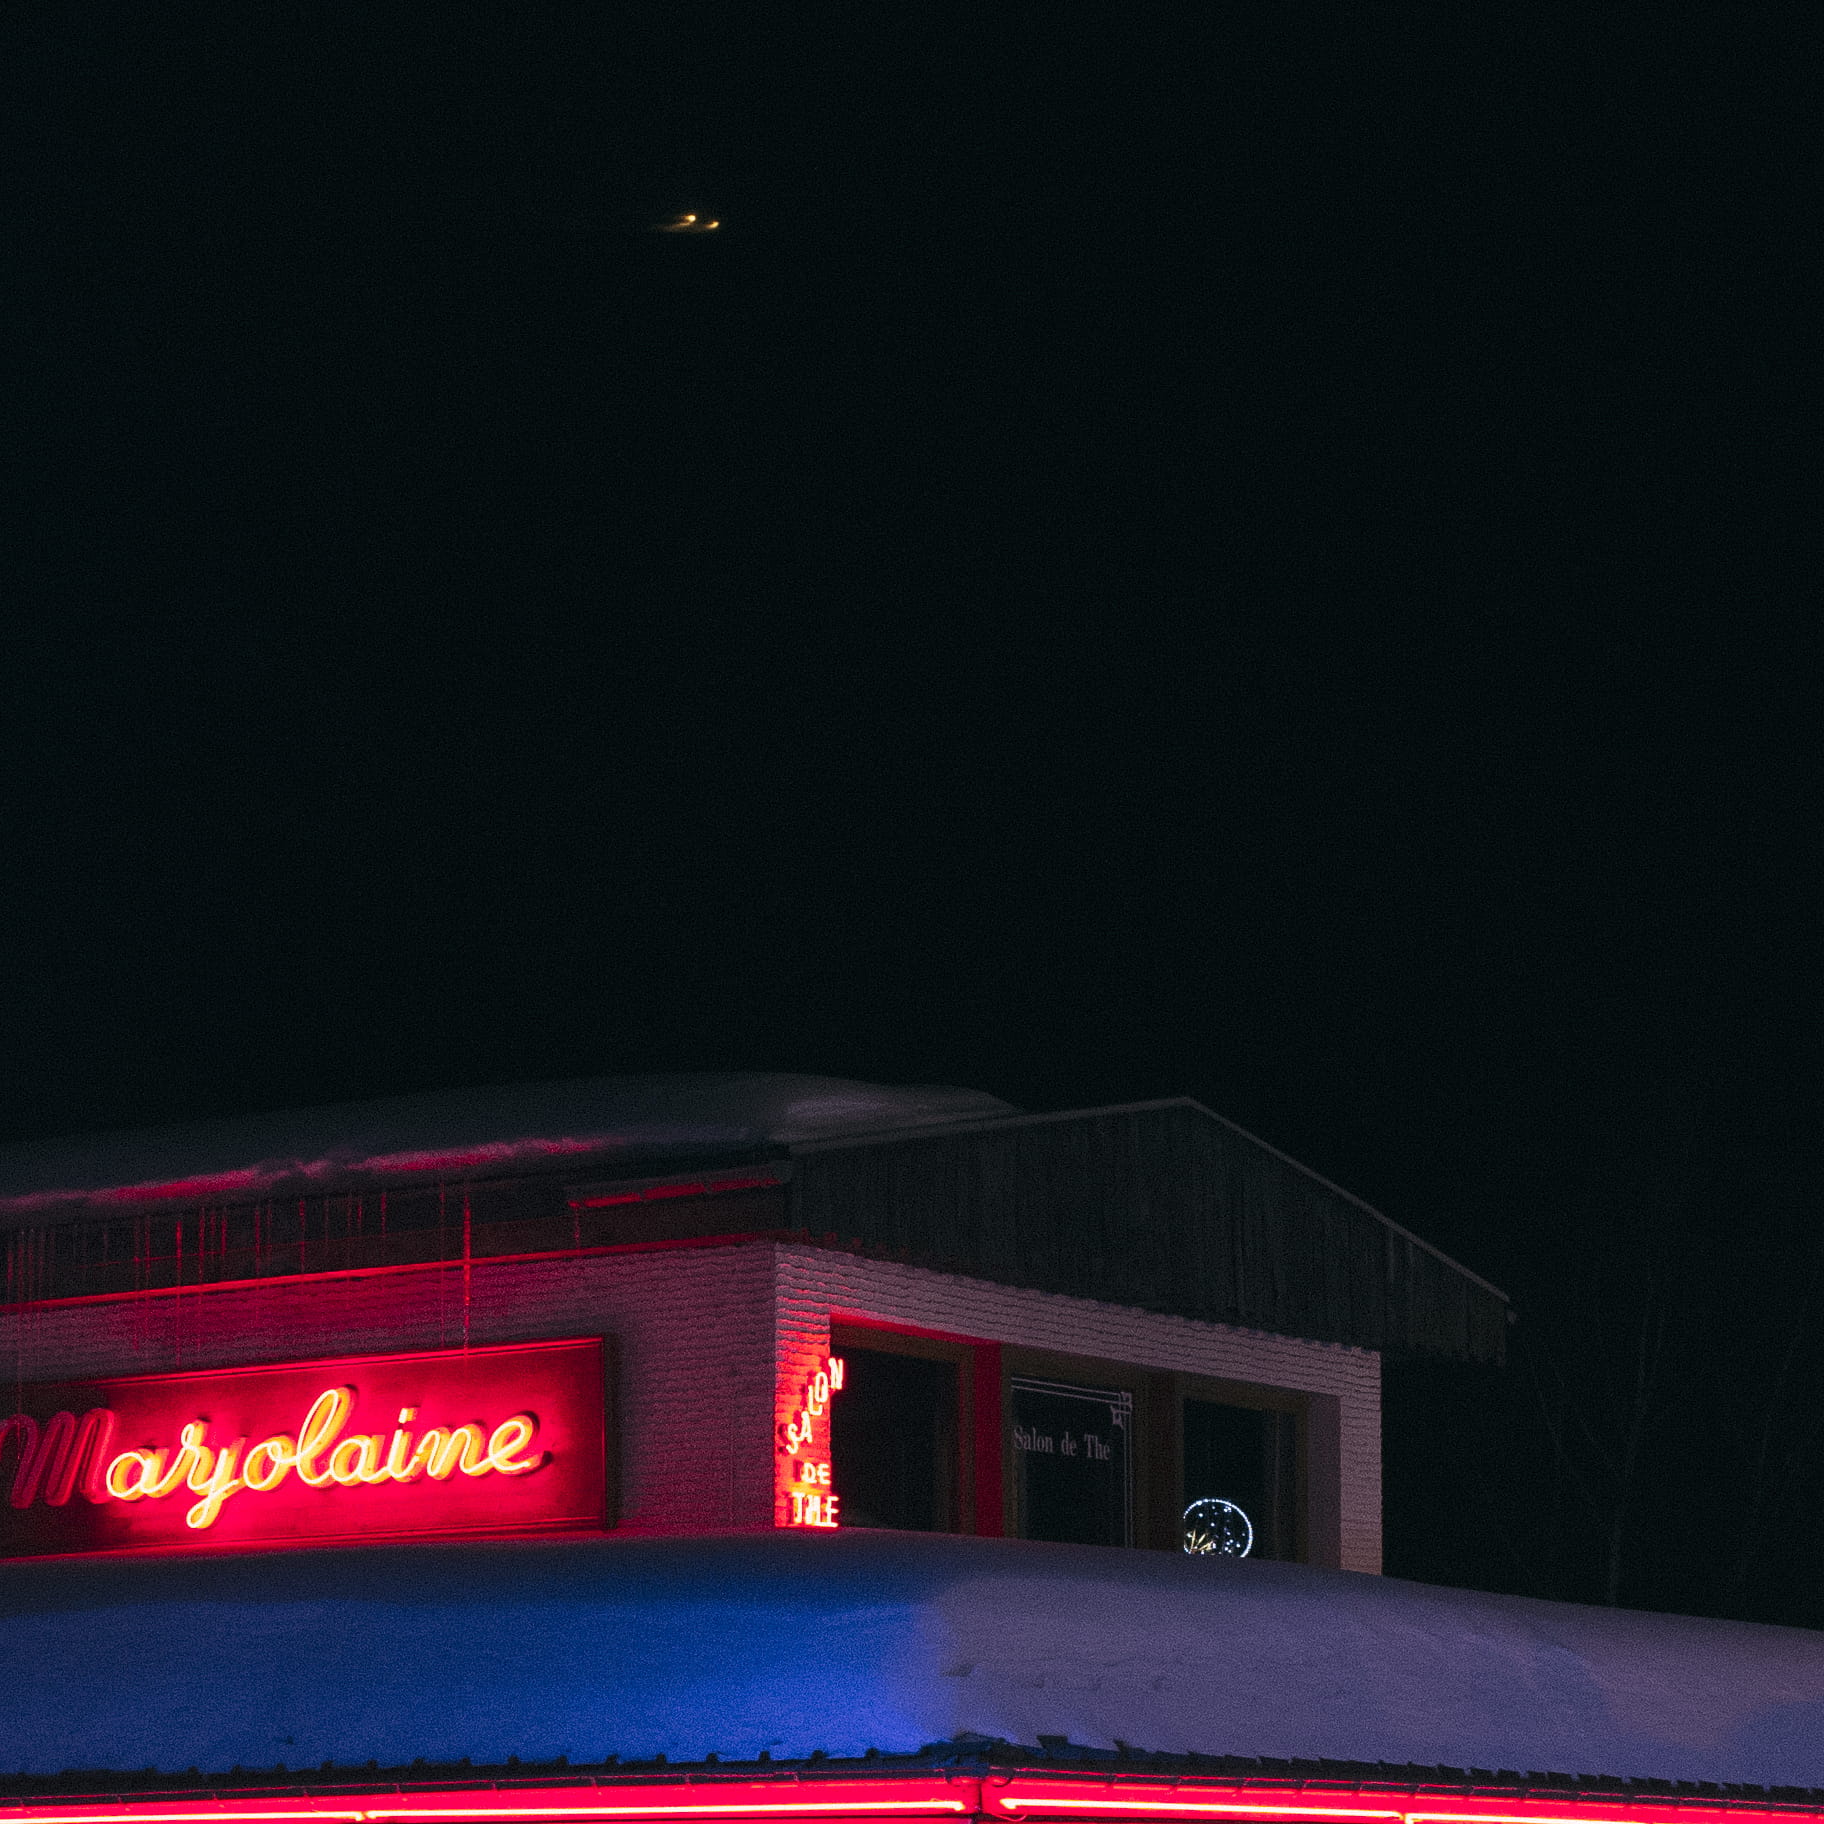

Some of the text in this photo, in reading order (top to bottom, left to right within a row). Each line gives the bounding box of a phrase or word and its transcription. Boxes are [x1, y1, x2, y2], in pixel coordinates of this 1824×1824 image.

[784, 1356, 844, 1455] SALON
[1012, 1425, 1054, 1455] Salon
[1060, 1430, 1078, 1456] de
[801, 1462, 832, 1485] DE
